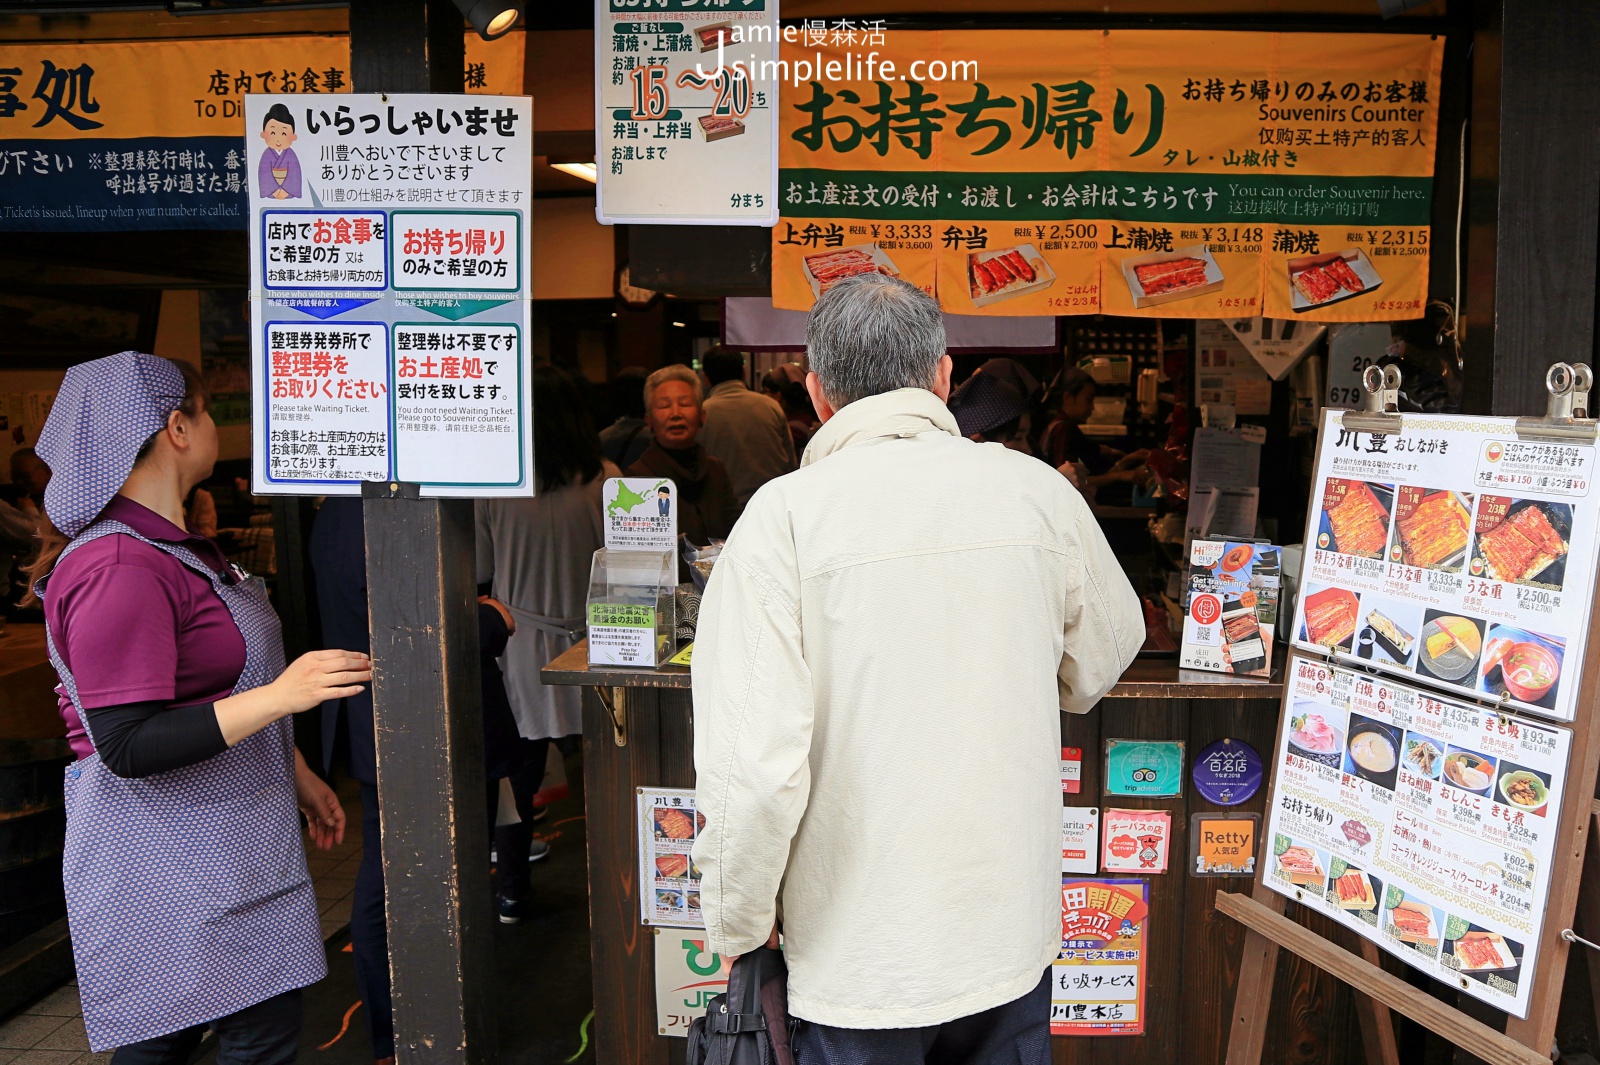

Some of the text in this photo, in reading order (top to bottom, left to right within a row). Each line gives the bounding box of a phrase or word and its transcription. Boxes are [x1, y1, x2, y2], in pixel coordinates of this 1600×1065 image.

[631, 24, 664, 33] ご飯なし
[612, 35, 692, 52] 蒲焼・上蒲焼
[208, 67, 345, 96] 店内でお食事
[612, 71, 624, 85] 約
[194, 100, 216, 117] To
[1259, 103, 1424, 122] Souvenirs Counter
[306, 105, 519, 137] いらっしゃいませ
[792, 78, 1429, 161] お持ち帰り お持ち帰りのみのお客様
[613, 122, 692, 139] 弁当・上弁当
[1258, 127, 1426, 147] 仅购买土特产的客人
[320, 144, 506, 163] 川豊へおいで下さいまして
[612, 146, 667, 160] お渡しまで
[1163, 149, 1298, 167] タレ・山椒付き
[321, 164, 474, 181] ありがとうございます
[612, 160, 623, 174] 約
[321, 188, 524, 203] 川豊の仕組みを説明させて頂きます
[785, 180, 1218, 211] お土産注文の受付・お渡し・お会計はこちらです
[1229, 183, 1425, 199] You can order Souvenir here.
[731, 194, 764, 208] 分まち
[42, 205, 74, 218] issued,
[111, 205, 132, 217] when
[137, 205, 155, 220] your
[158, 203, 197, 217] number
[200, 204, 207, 216] is
[208, 203, 240, 216] called.
[268, 218, 384, 244] 店内でお食事を
[778, 223, 932, 247] 上弁当 税抜 ¥3,333
[941, 224, 1098, 250] 弁当 税抜 ¥2,500
[1103, 224, 1264, 253] 上蒲焼 税抜 ¥3,148
[404, 228, 505, 256] お持ち帰り
[1272, 229, 1428, 255] 蒲焼 税抜 ¥2,315
[269, 245, 364, 264] ご希望の方 又は
[268, 269, 383, 282] お食事とお持ち帰り両方の方
[403, 258, 508, 277] のみご希望の方
[267, 290, 289, 298] Those
[293, 290, 308, 298] who
[309, 290, 334, 298] wishes
[468, 292, 482, 301] buy
[1066, 286, 1098, 294] ごはん付
[271, 331, 372, 350] 整理券発券所で
[398, 332, 517, 351] 整理券は不要です
[272, 351, 349, 377] 整理券を
[398, 356, 498, 379] お土産処で
[272, 379, 387, 399] お取りください
[398, 384, 507, 400] 受付を致します。
[1331, 388, 1360, 403] 679
[273, 404, 295, 412] Please
[314, 405, 343, 414] Waiting
[345, 405, 370, 413] Ticket.
[459, 407, 488, 415] Waiting
[271, 430, 386, 443] お食事とお土産両方の方は
[271, 443, 386, 457] お食事の際、お土産注文を
[1395, 437, 1448, 454] おしながき
[271, 457, 341, 469] 承っております。
[1194, 546, 1204, 556] Hi
[1315, 550, 1352, 569] 特上うな重
[1193, 576, 1230, 587] Get Travel
[1385, 564, 1422, 584] 上うな重
[1468, 579, 1503, 599] うな重
[1210, 759, 1247, 773] 百名店
[1125, 784, 1162, 792] tripadvisor
[1440, 786, 1481, 810] おしんこ
[1281, 795, 1334, 825] お持ち帰り
[1396, 810, 1418, 827] ビール
[1491, 804, 1525, 826] きも煮
[1110, 823, 1163, 834] チーパスの店
[1205, 832, 1250, 847] Retty
[1213, 847, 1239, 855] 人気店
[1062, 887, 1135, 920] 田開運
[1052, 1004, 1123, 1020] 川豊本店
